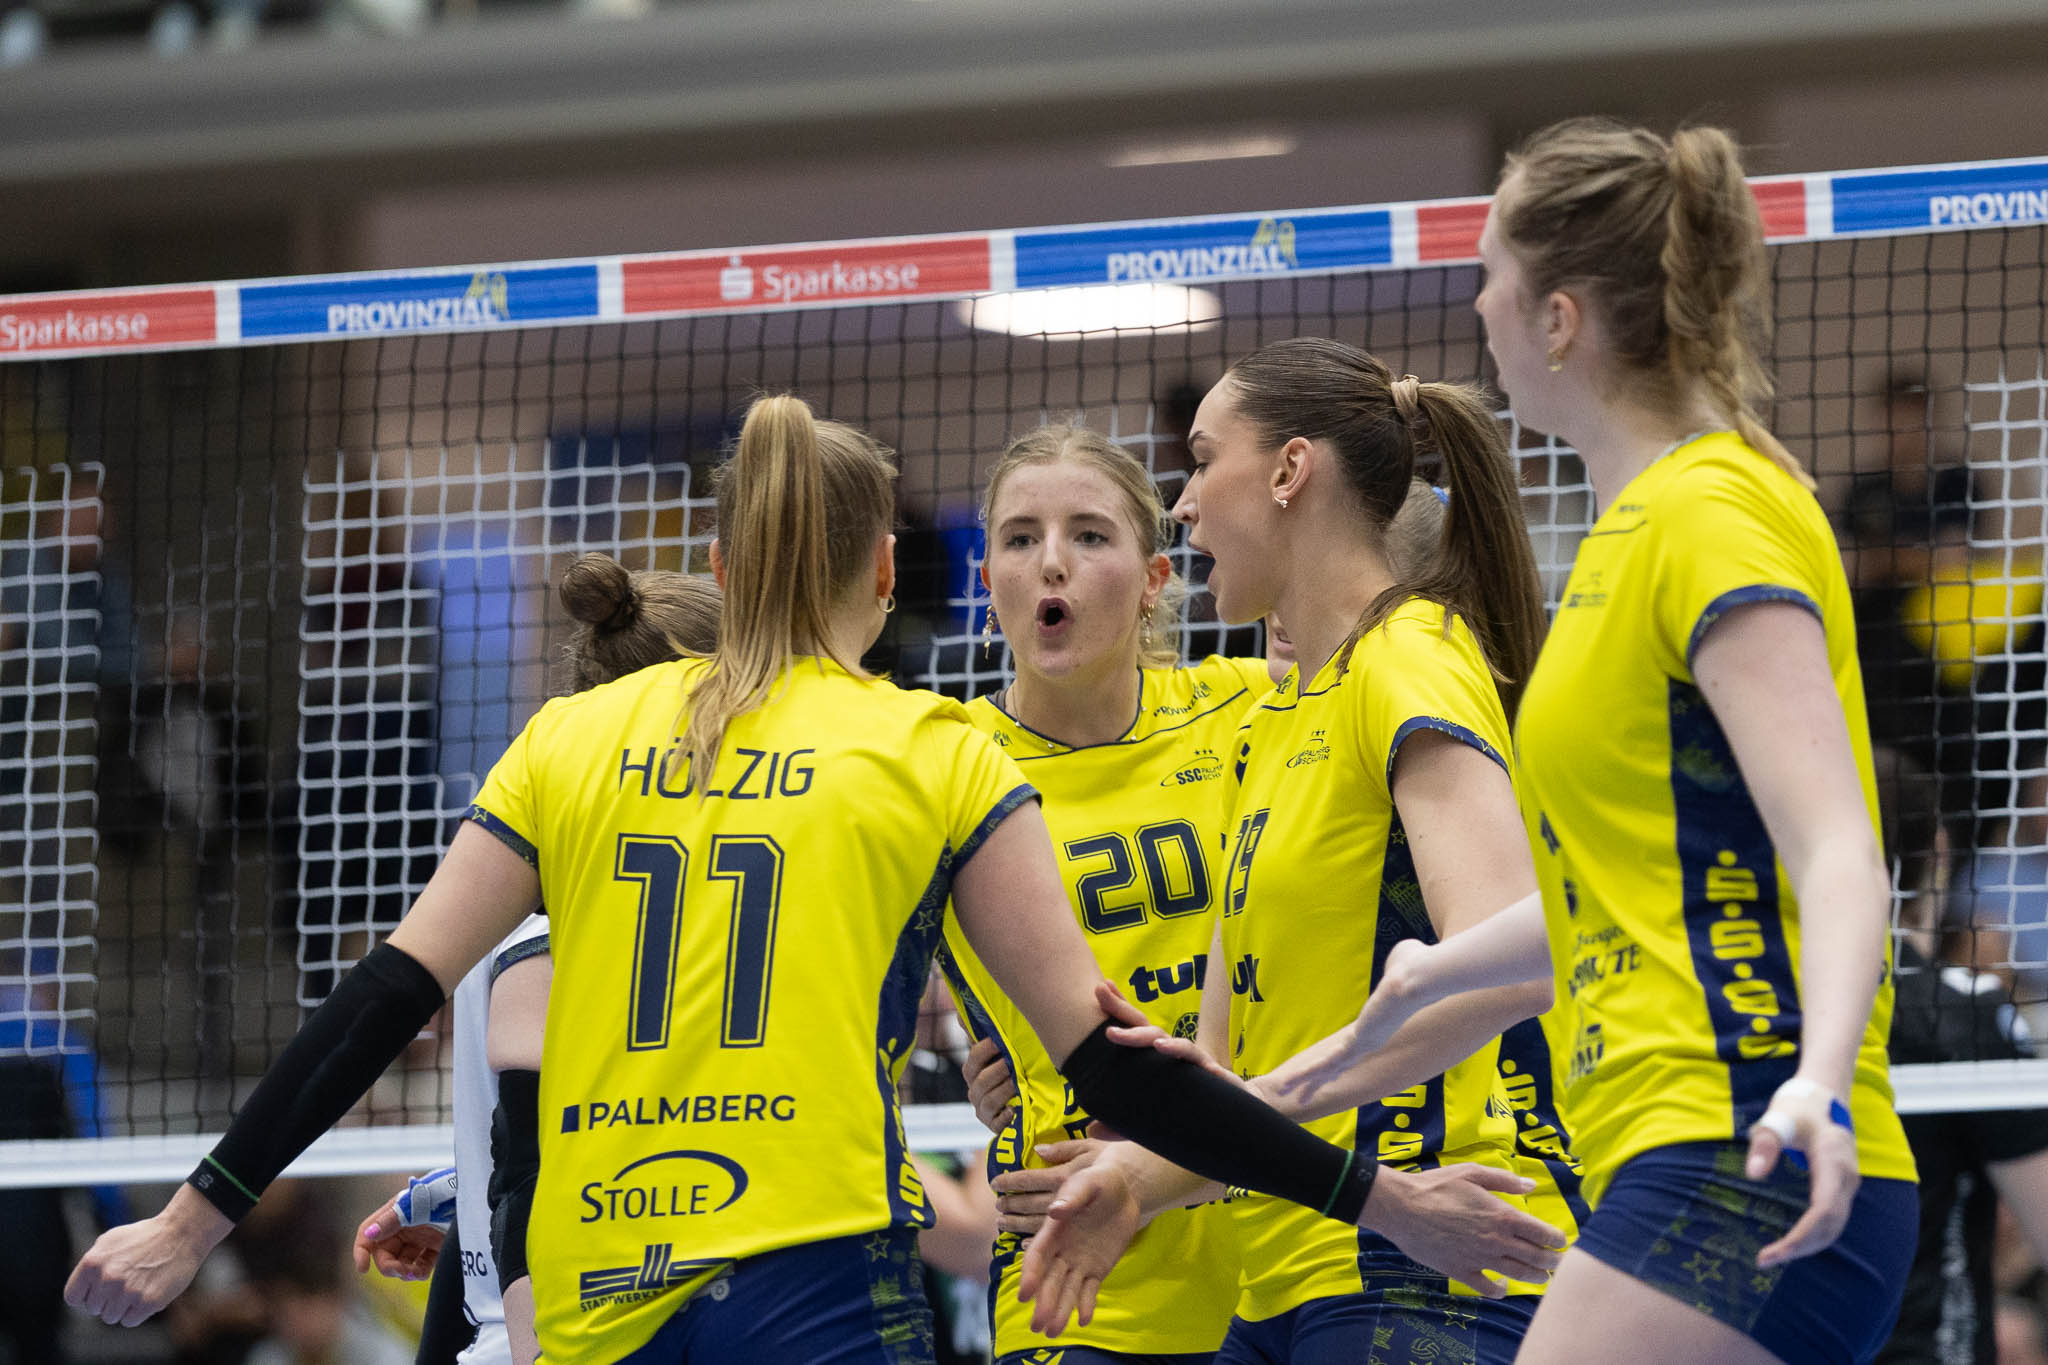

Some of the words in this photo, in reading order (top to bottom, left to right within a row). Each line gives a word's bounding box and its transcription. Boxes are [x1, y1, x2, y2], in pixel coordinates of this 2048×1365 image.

[762, 260, 920, 303] Sparkasse
[1107, 243, 1289, 282] PROVINZIAL
[0, 311, 149, 351] Sparkasse
[327, 296, 497, 334] PROVINZIAL
[1175, 768, 1203, 785] SSC
[1063, 818, 1214, 935] 20
[612, 832, 785, 1052] 11
[588, 1093, 796, 1131] PALMBERG
[581, 1181, 710, 1223] STOLLE
[580, 1288, 660, 1313] STADWERK
